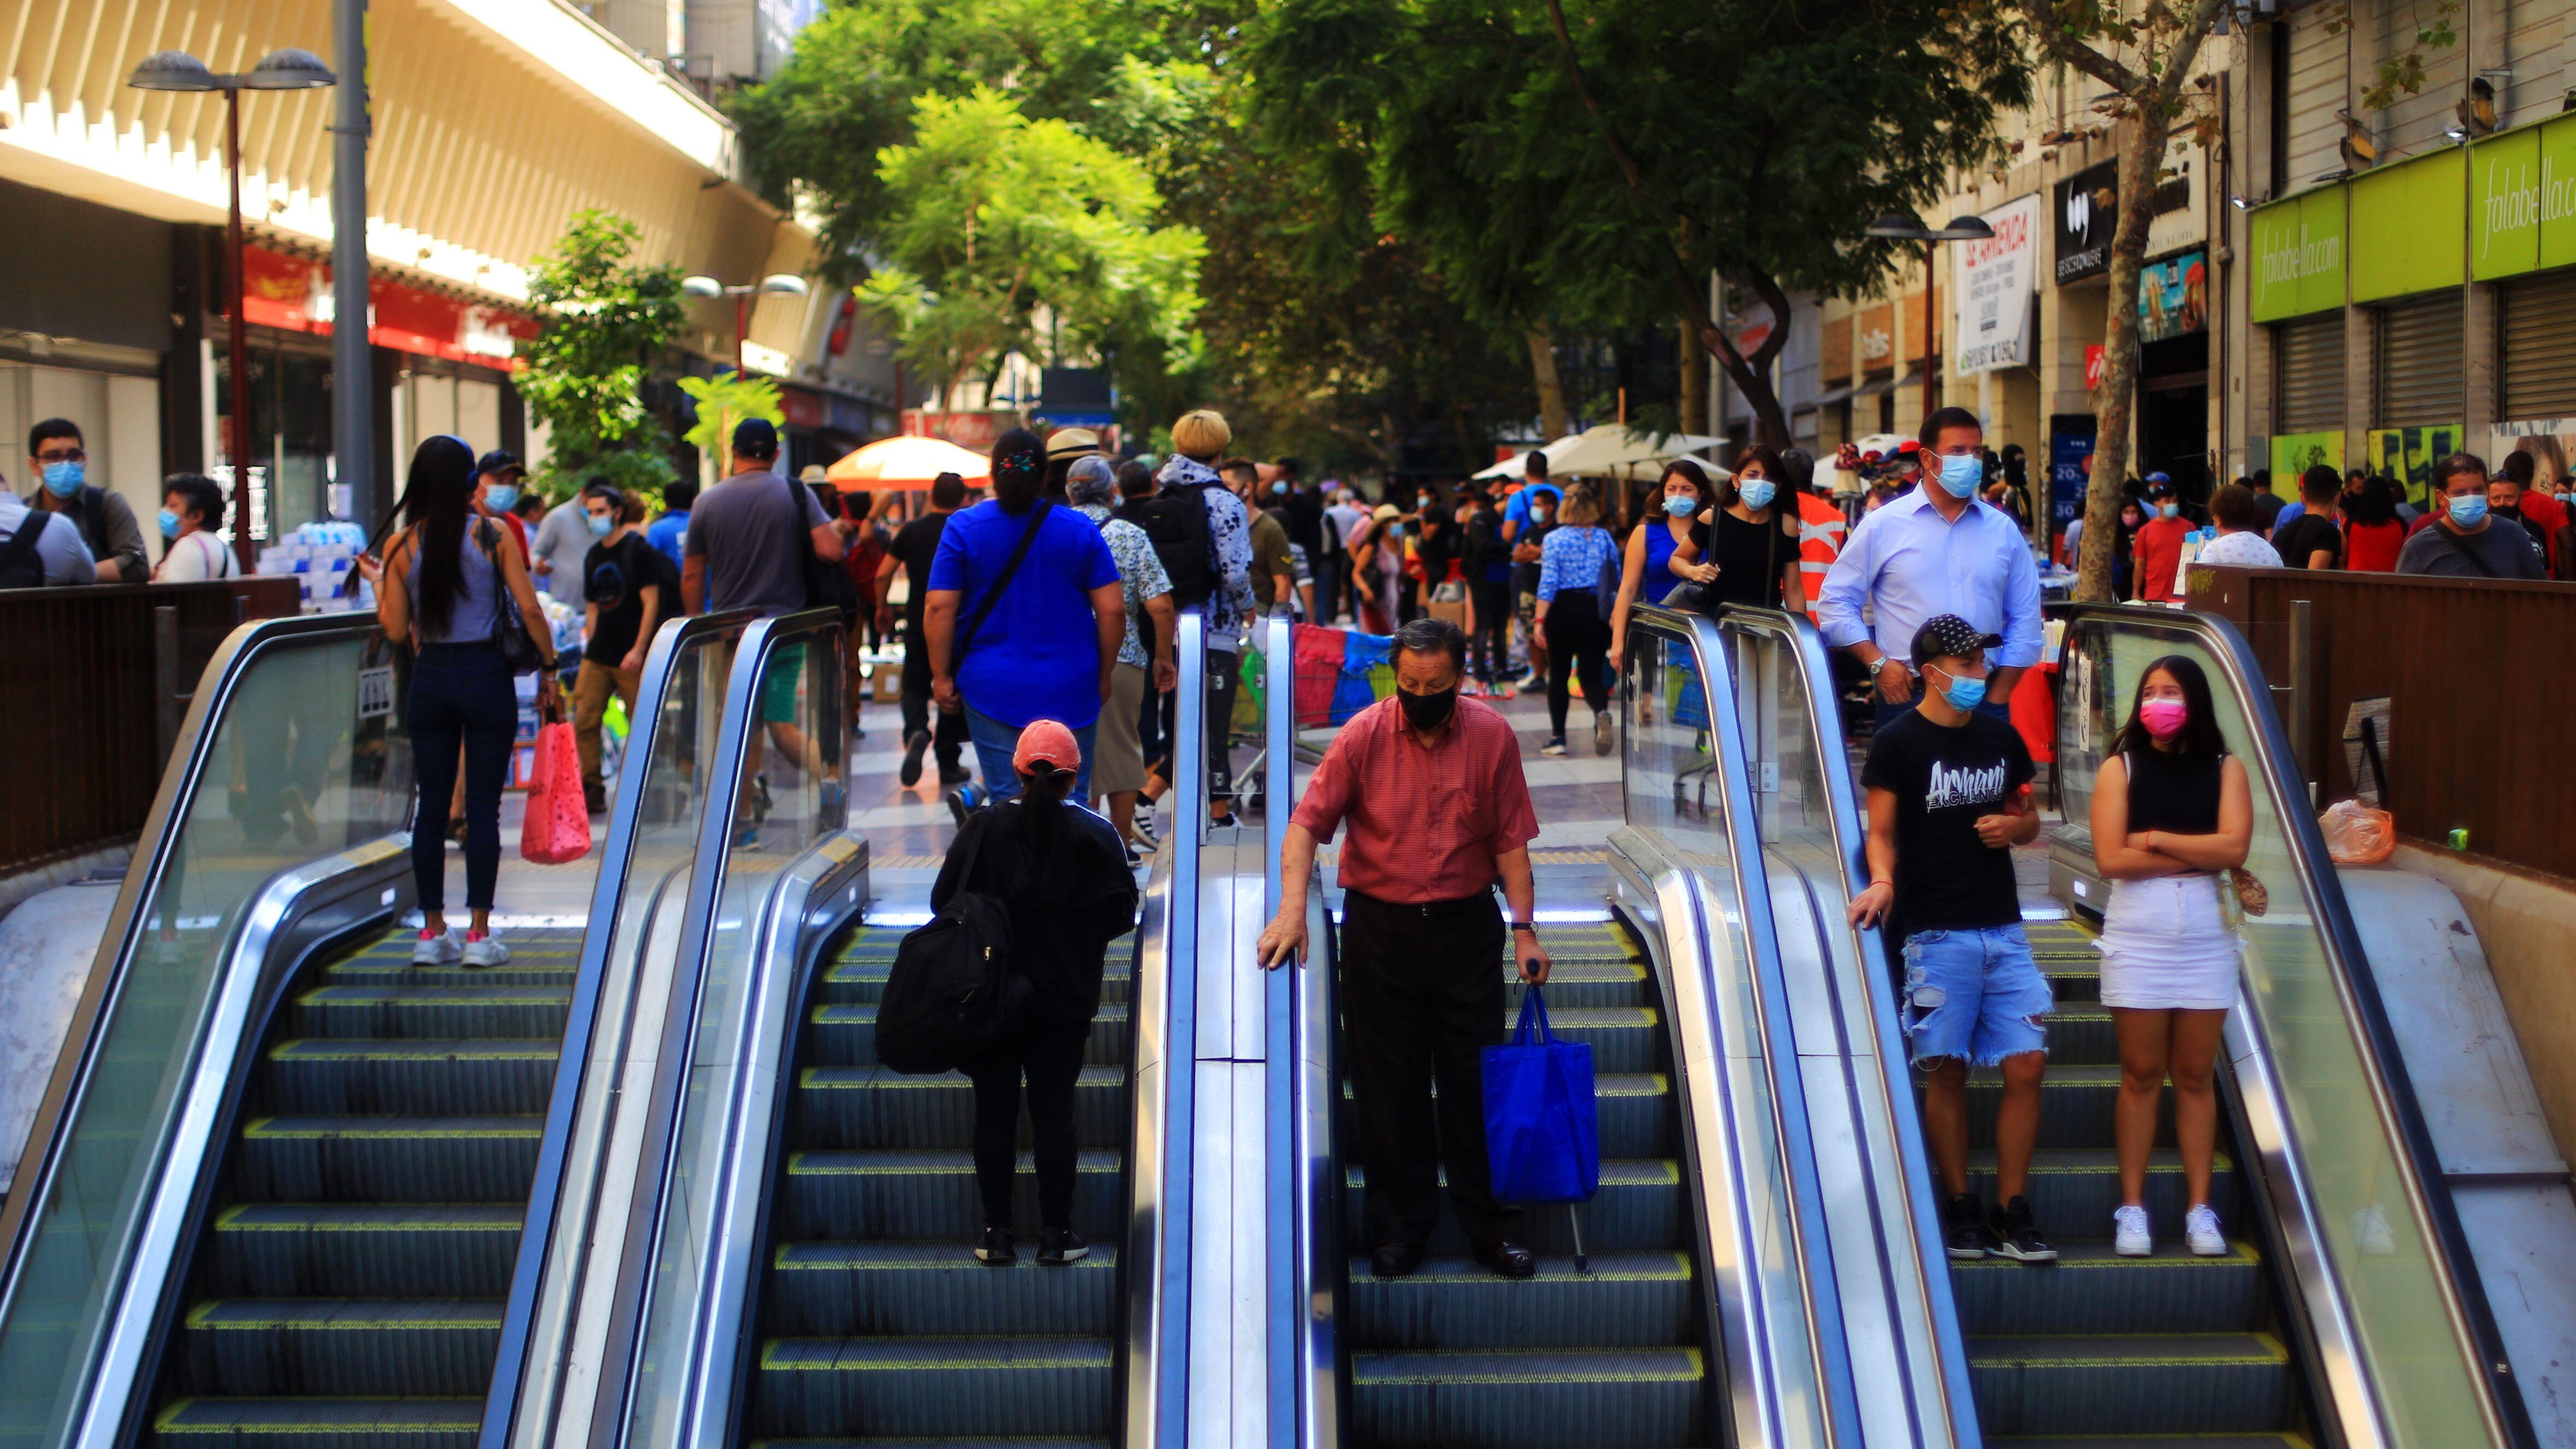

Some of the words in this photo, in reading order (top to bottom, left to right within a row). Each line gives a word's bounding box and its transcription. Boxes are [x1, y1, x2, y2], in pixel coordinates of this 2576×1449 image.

[2482, 155, 2576, 260] falabella.c
[2260, 222, 2339, 306] falabella.com
[1925, 786, 2005, 810] EXCHANGE
[1926, 758, 2005, 802] Armani
